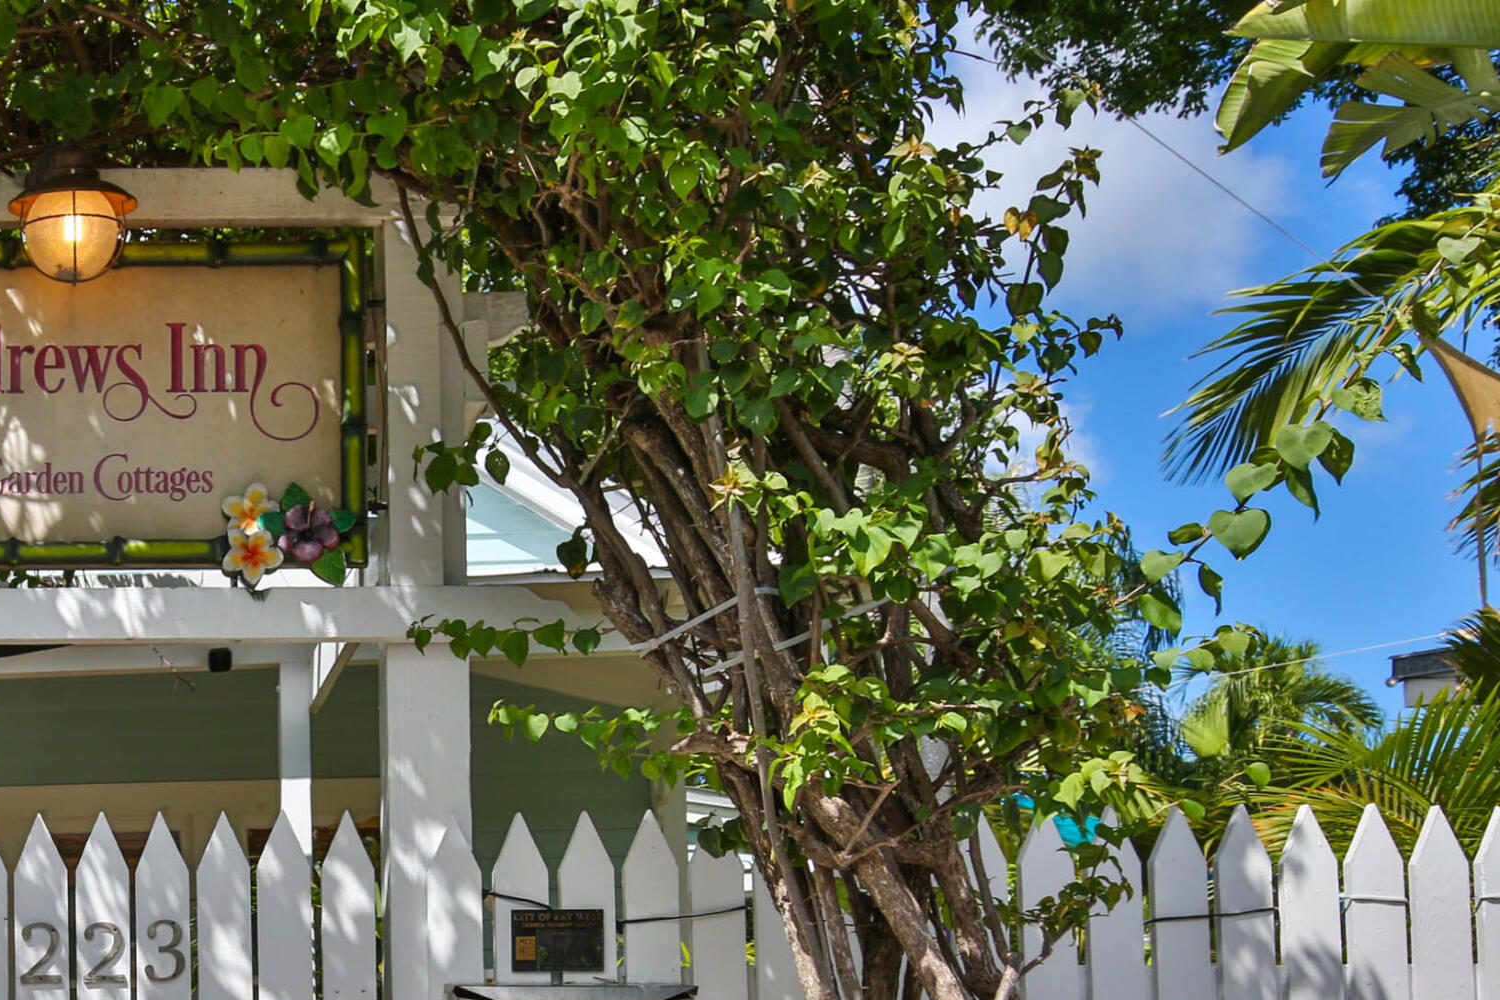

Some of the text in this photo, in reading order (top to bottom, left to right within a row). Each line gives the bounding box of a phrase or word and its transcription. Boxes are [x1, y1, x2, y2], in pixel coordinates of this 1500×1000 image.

[166, 322, 319, 441] Inn
[93, 453, 214, 502] Cottages
[20, 919, 186, 988] 223
